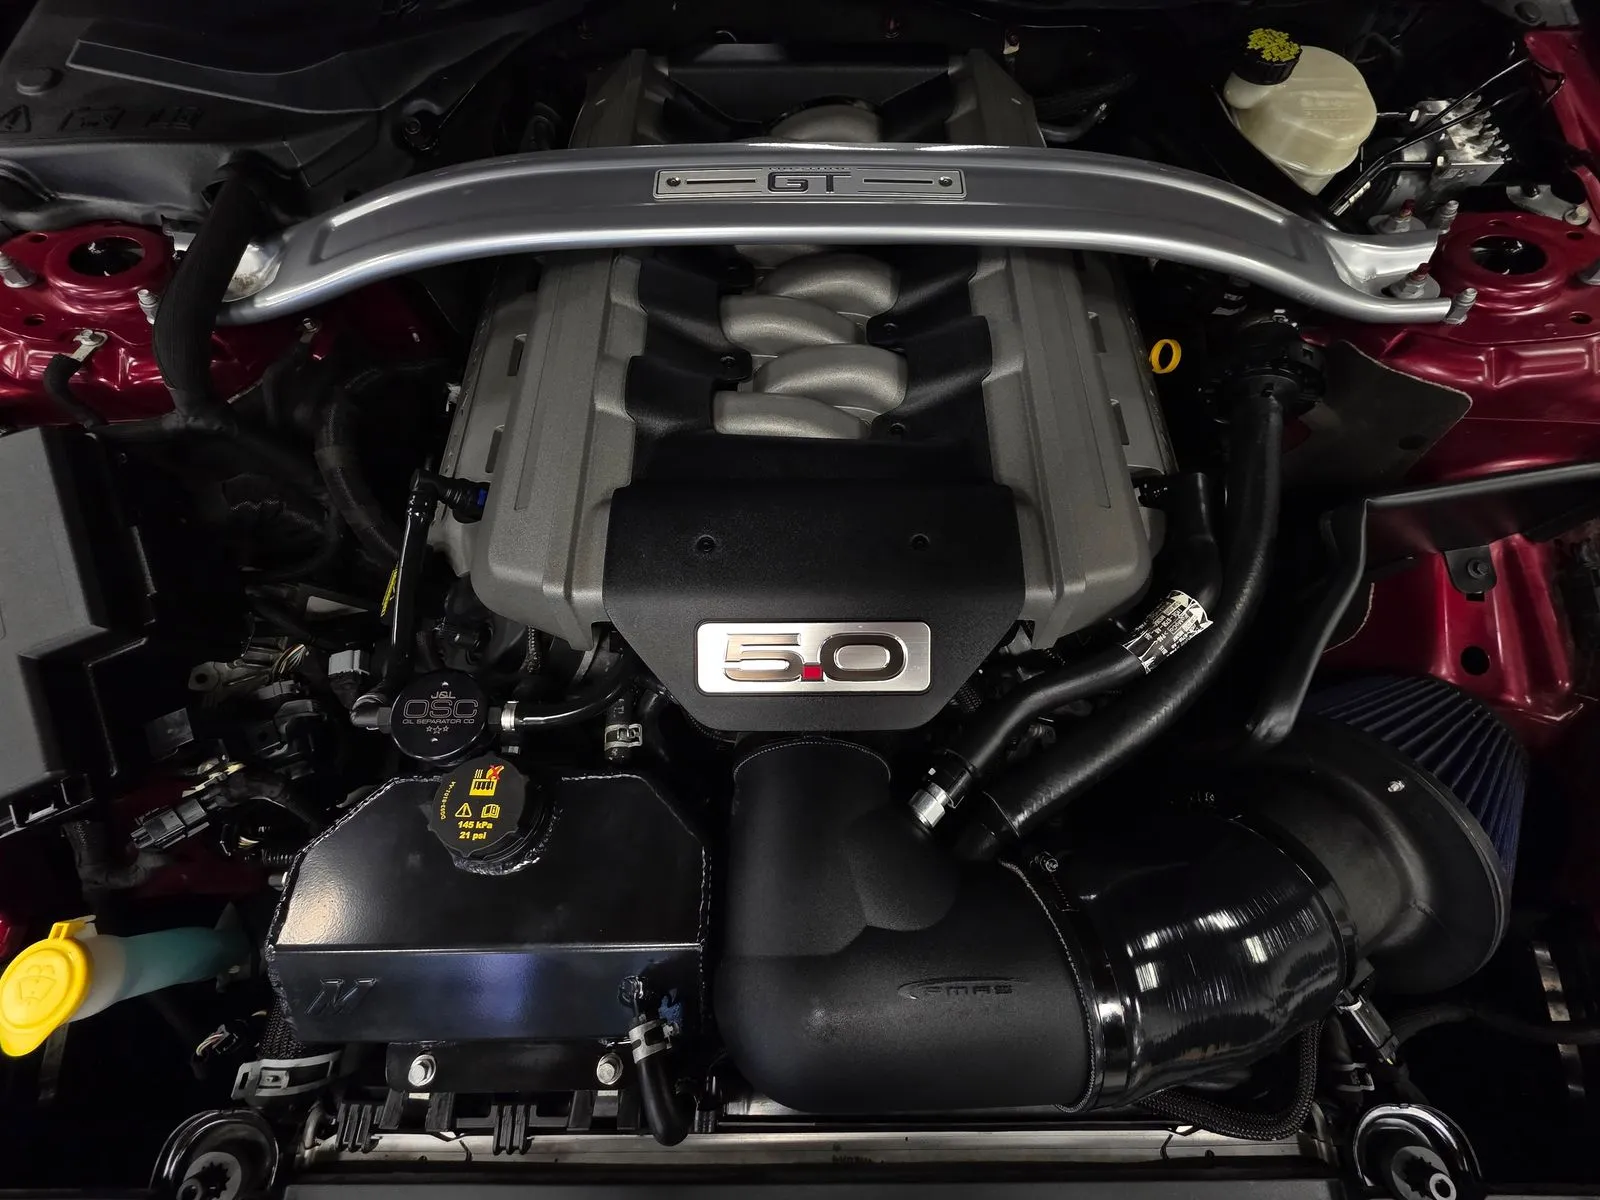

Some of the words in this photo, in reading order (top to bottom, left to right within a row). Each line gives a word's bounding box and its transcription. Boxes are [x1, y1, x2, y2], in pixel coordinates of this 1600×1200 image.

[767, 171, 852, 194] GT
[724, 632, 909, 683] 5.0
[430, 690, 456, 699] J&L
[403, 699, 479, 719] OSC
[458, 821, 474, 829] 145
[475, 821, 493, 829] kPa
[472, 832, 487, 841] psi
